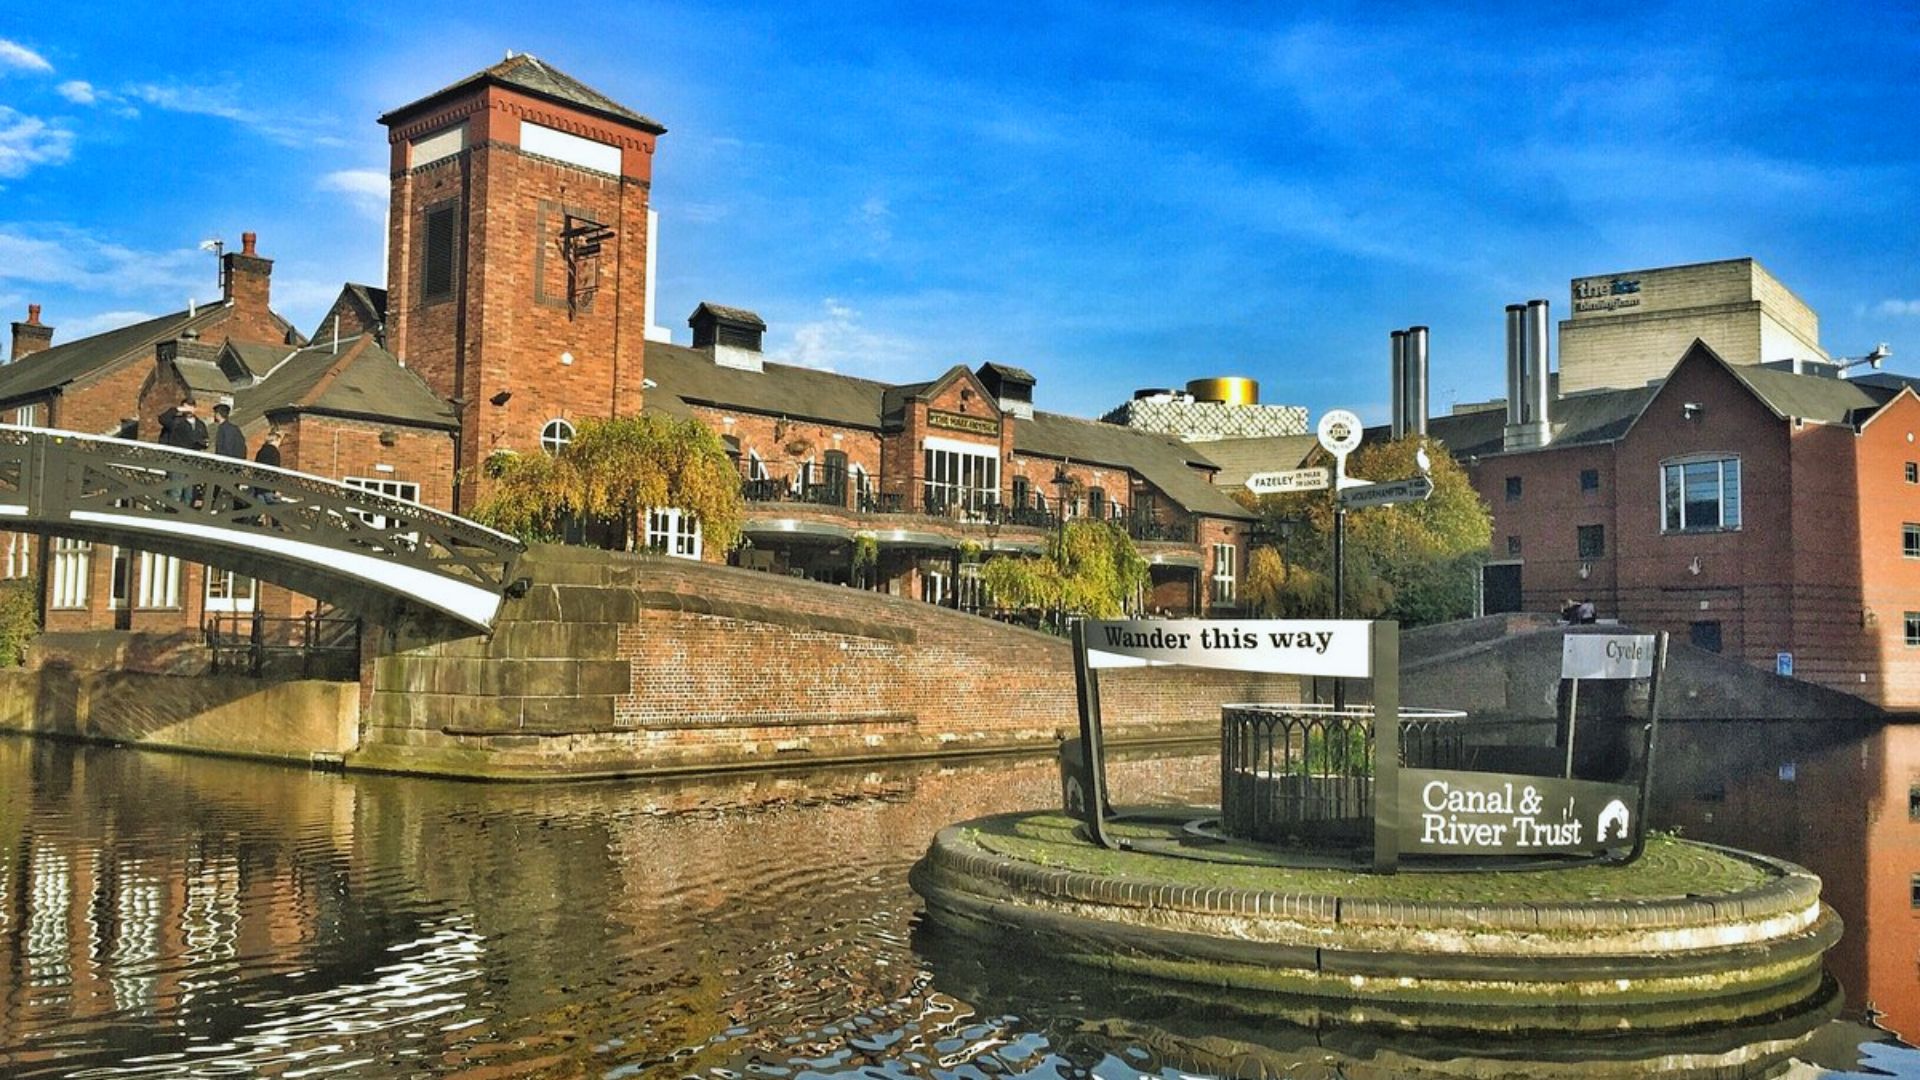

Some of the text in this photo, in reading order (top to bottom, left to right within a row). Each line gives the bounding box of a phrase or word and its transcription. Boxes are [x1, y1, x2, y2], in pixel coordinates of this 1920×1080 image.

[1578, 282, 1610, 298] the
[1255, 476, 1294, 487] FAZELEY
[1104, 626, 1334, 654] Wander this way
[1606, 640, 1642, 664] Cycle
[1423, 781, 1544, 814] Canal &
[1420, 814, 1582, 846] River Trust
